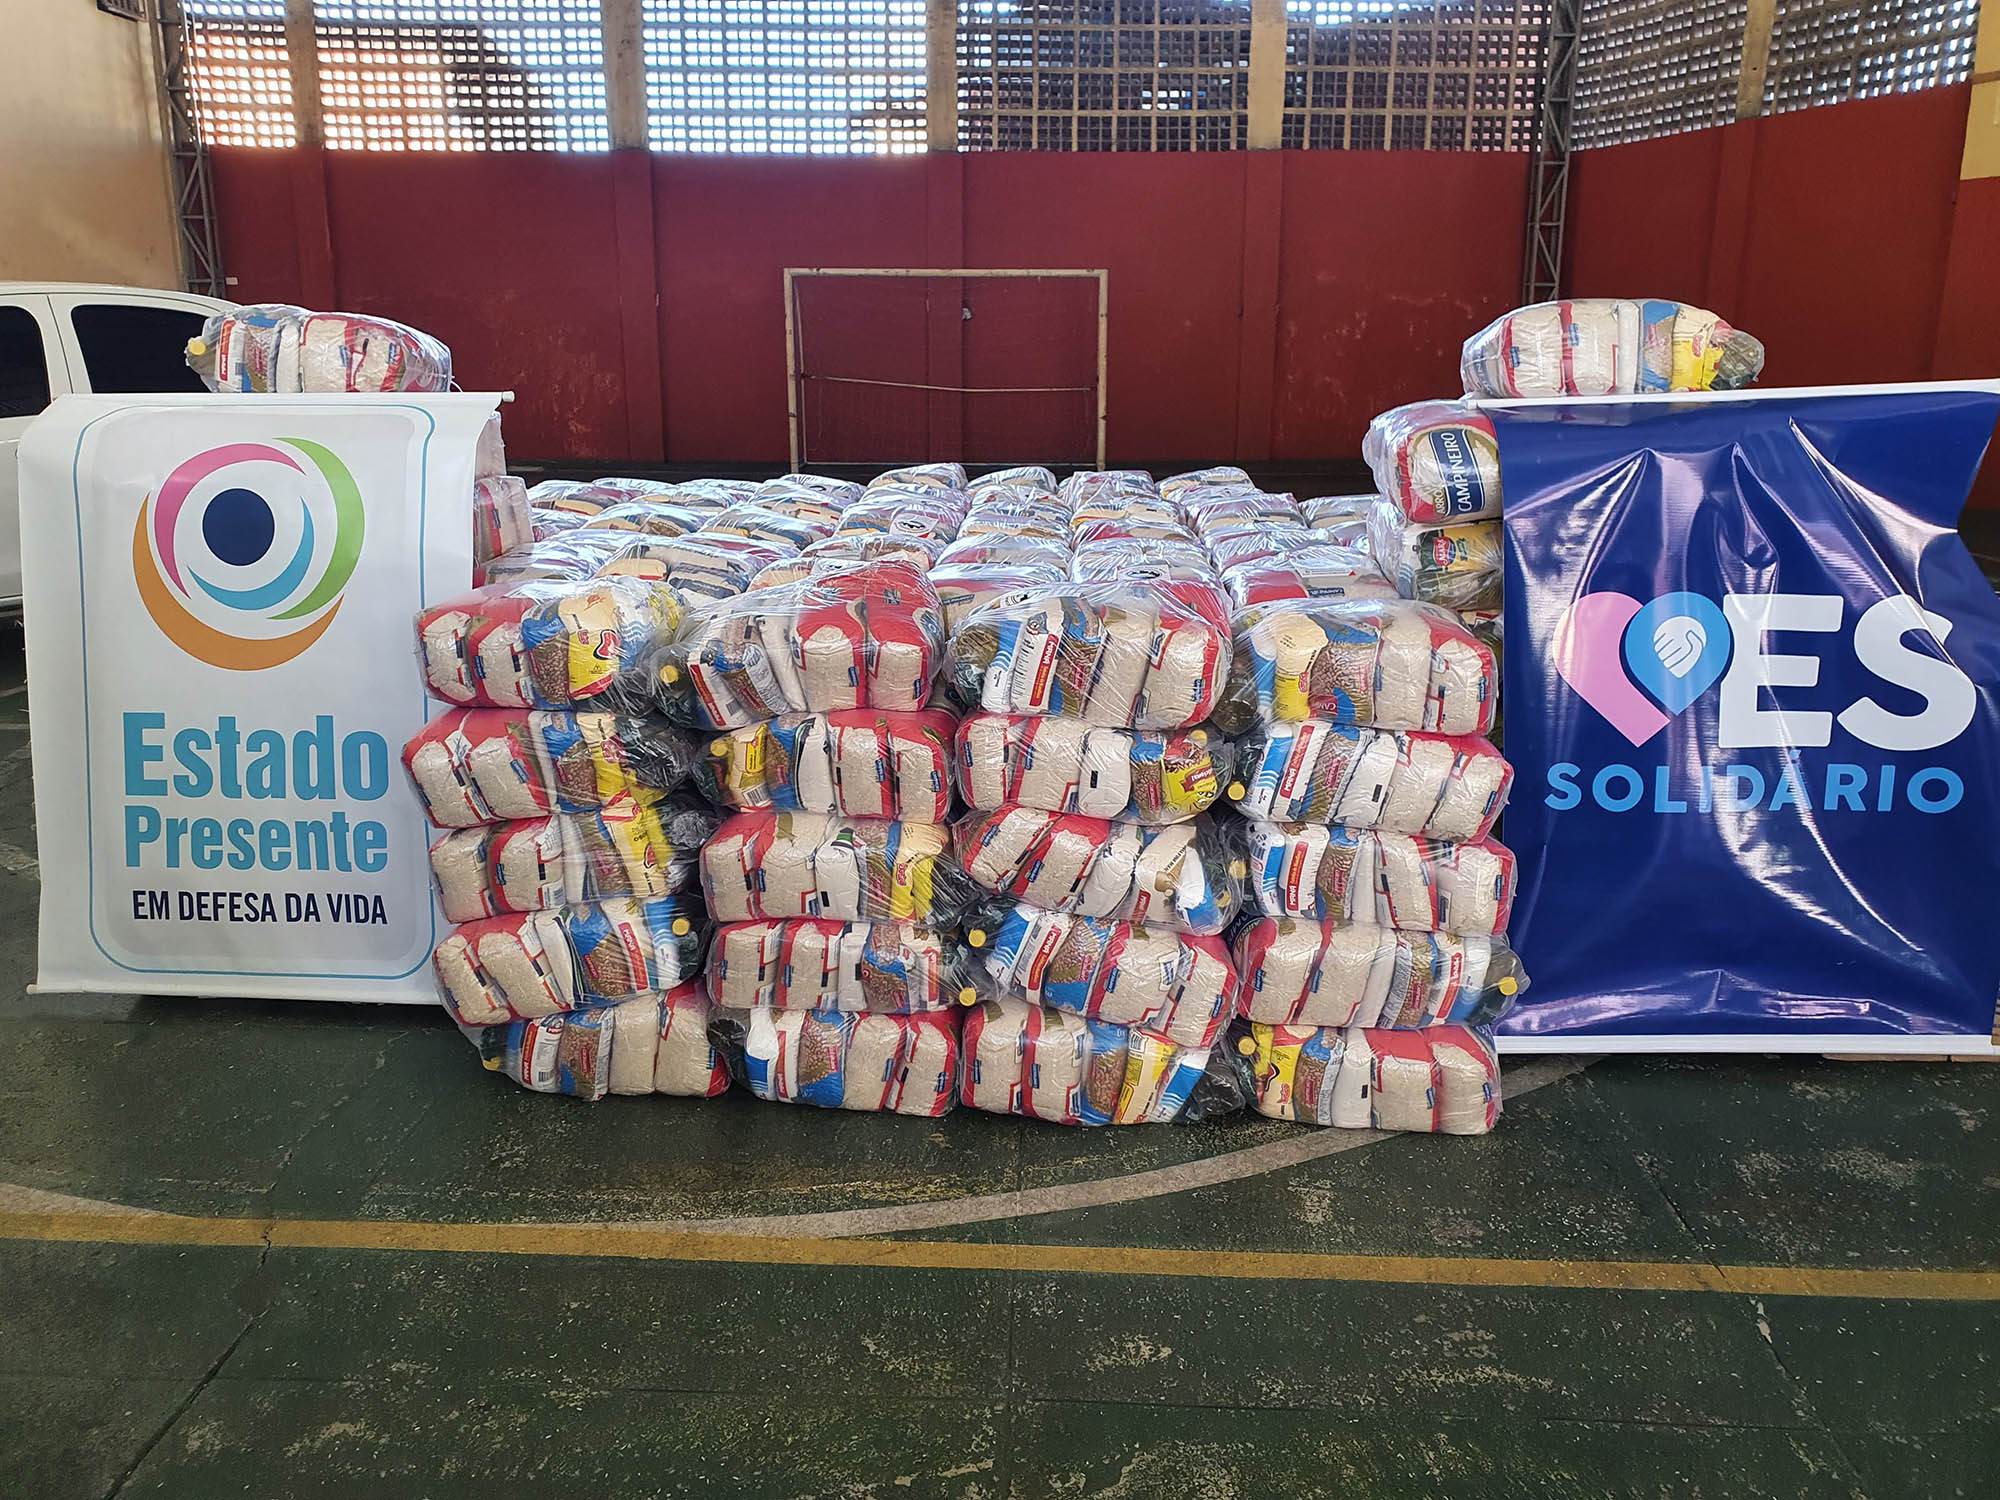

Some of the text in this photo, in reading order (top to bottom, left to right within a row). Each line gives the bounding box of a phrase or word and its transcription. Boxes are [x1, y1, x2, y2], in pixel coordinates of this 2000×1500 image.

[1432, 488, 1446, 515] ARRO
[1440, 431, 1473, 513] CAMPINEIRO
[1718, 593, 1977, 752] ES
[122, 712, 390, 801] Estado
[1543, 749, 1966, 815] SOLIDÁRIO
[124, 804, 389, 873] Presente
[132, 889, 388, 925] EM DEFESA DA VIDA
